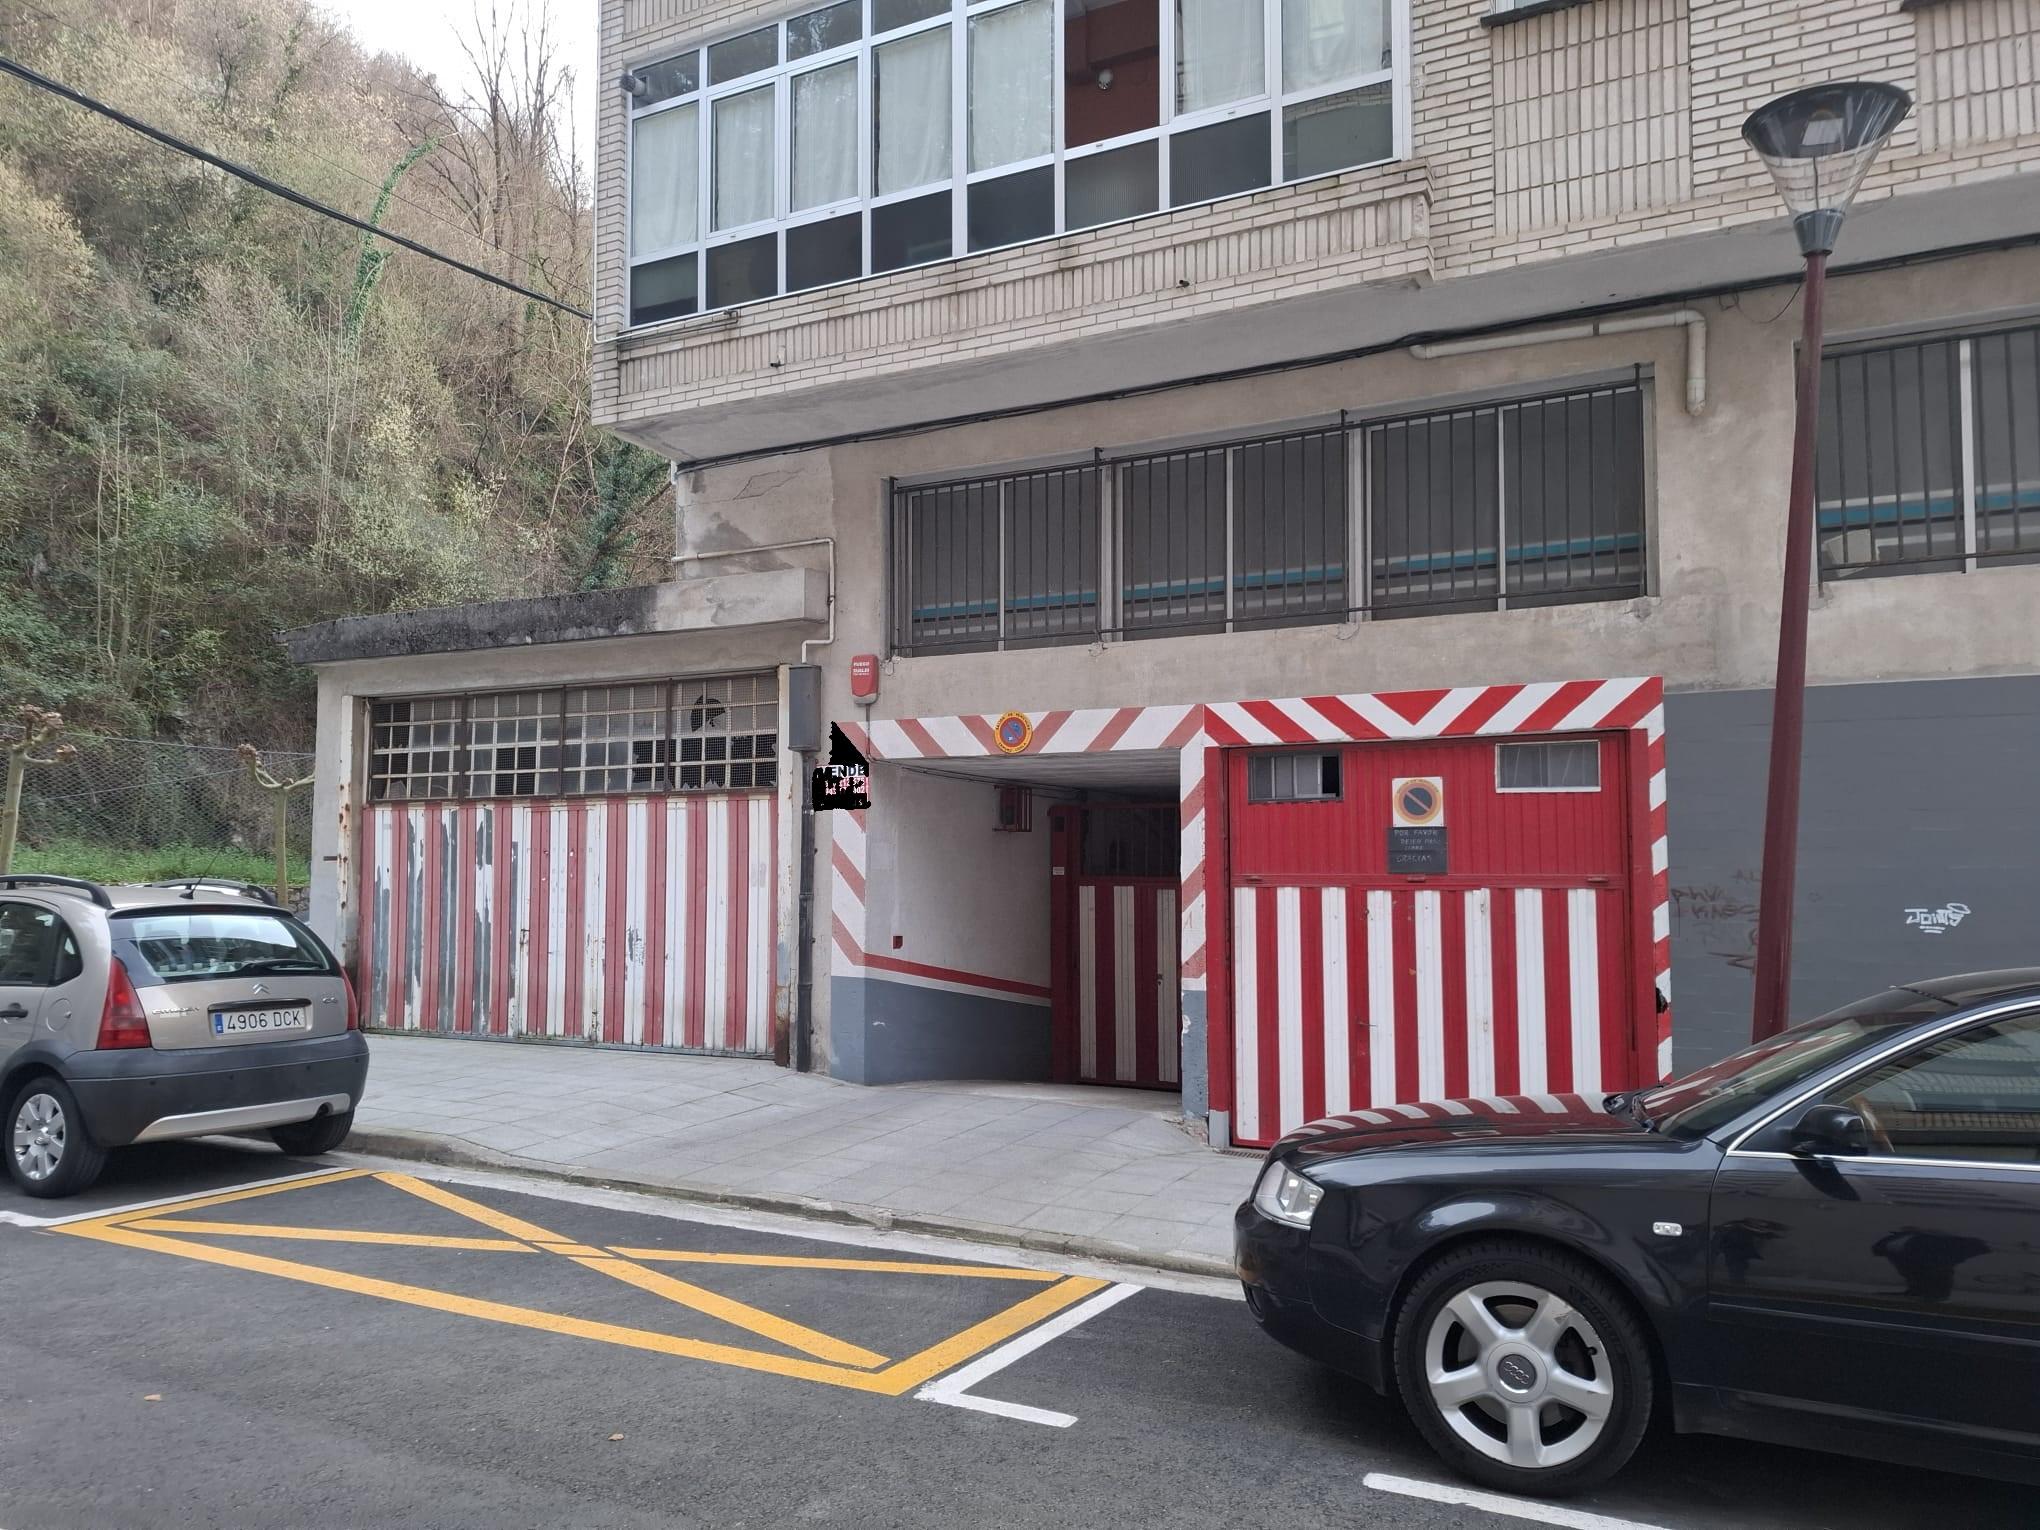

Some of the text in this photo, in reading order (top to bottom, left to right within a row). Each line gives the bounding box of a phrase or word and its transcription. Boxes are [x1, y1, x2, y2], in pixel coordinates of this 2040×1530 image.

[820, 765, 865, 777] ENDE
[227, 1010, 301, 1032] 4906 DCK
